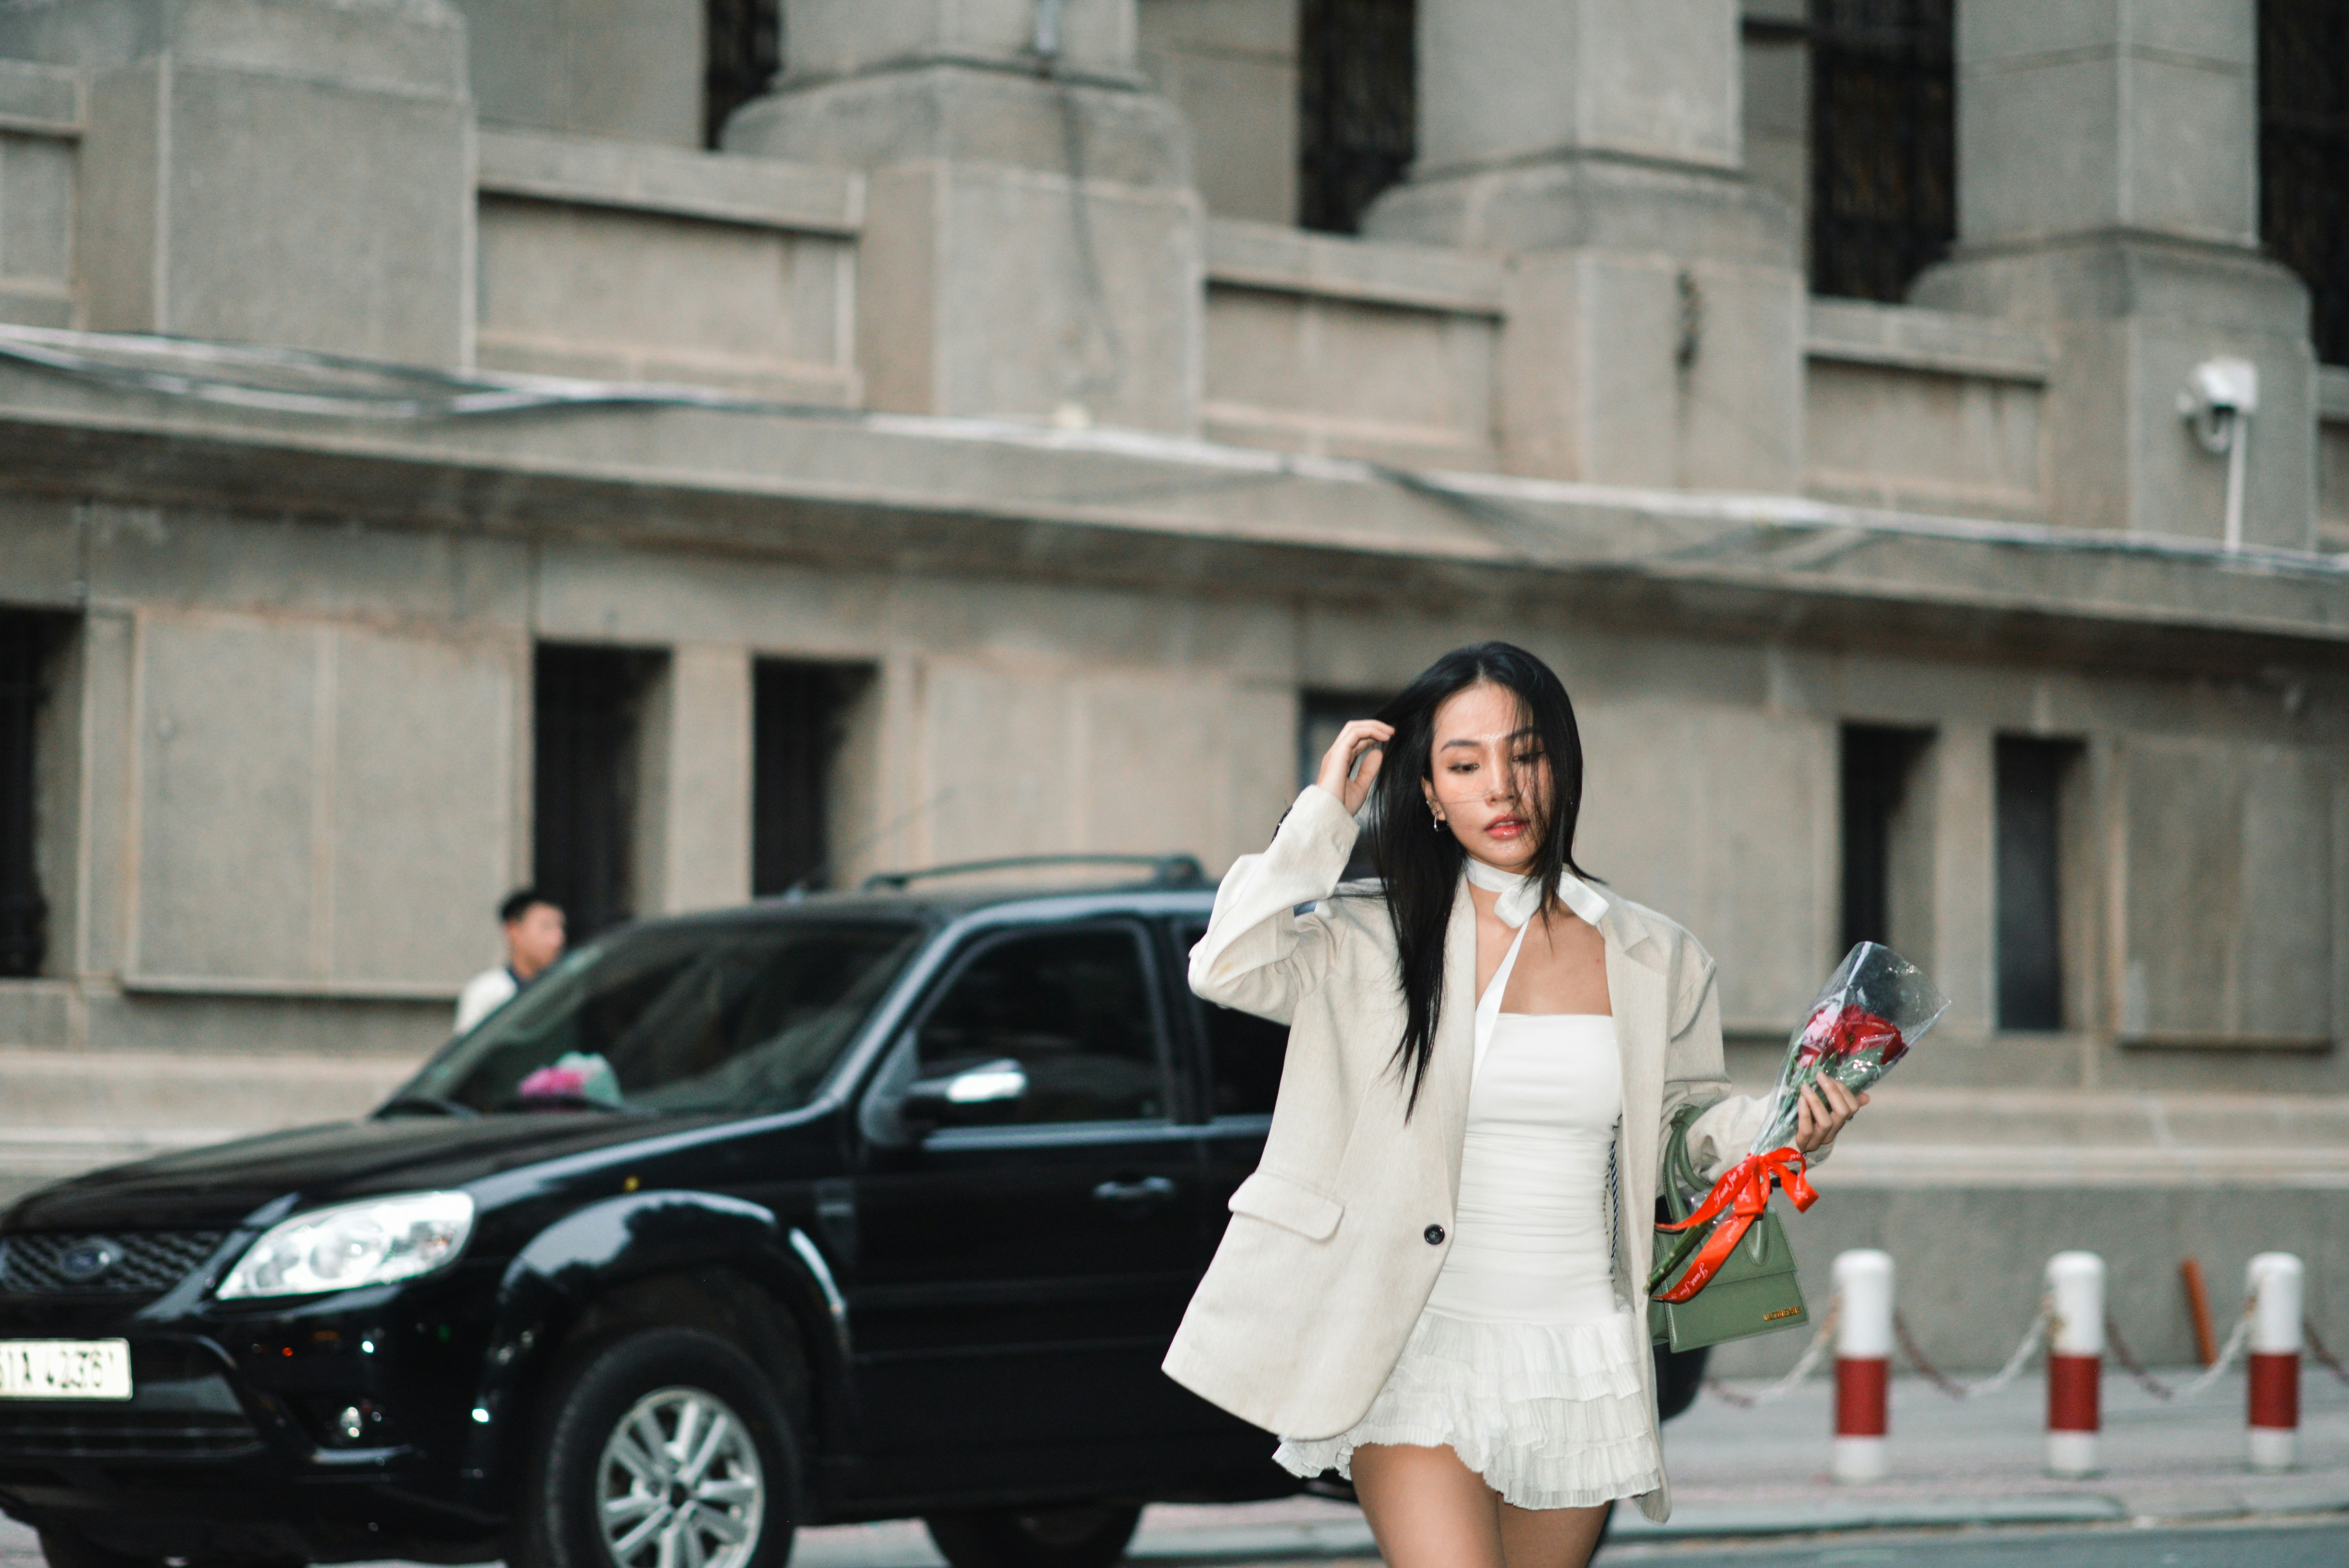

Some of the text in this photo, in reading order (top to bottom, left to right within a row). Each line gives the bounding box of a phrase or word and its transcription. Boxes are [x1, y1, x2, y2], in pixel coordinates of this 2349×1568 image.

[1714, 1183, 1729, 1208] Just
[1727, 1172, 1737, 1191] for
[1690, 1262, 1708, 1286] Just
[1680, 1281, 1690, 1295] for
[1763, 1306, 1802, 1322] JACQUEMUS
